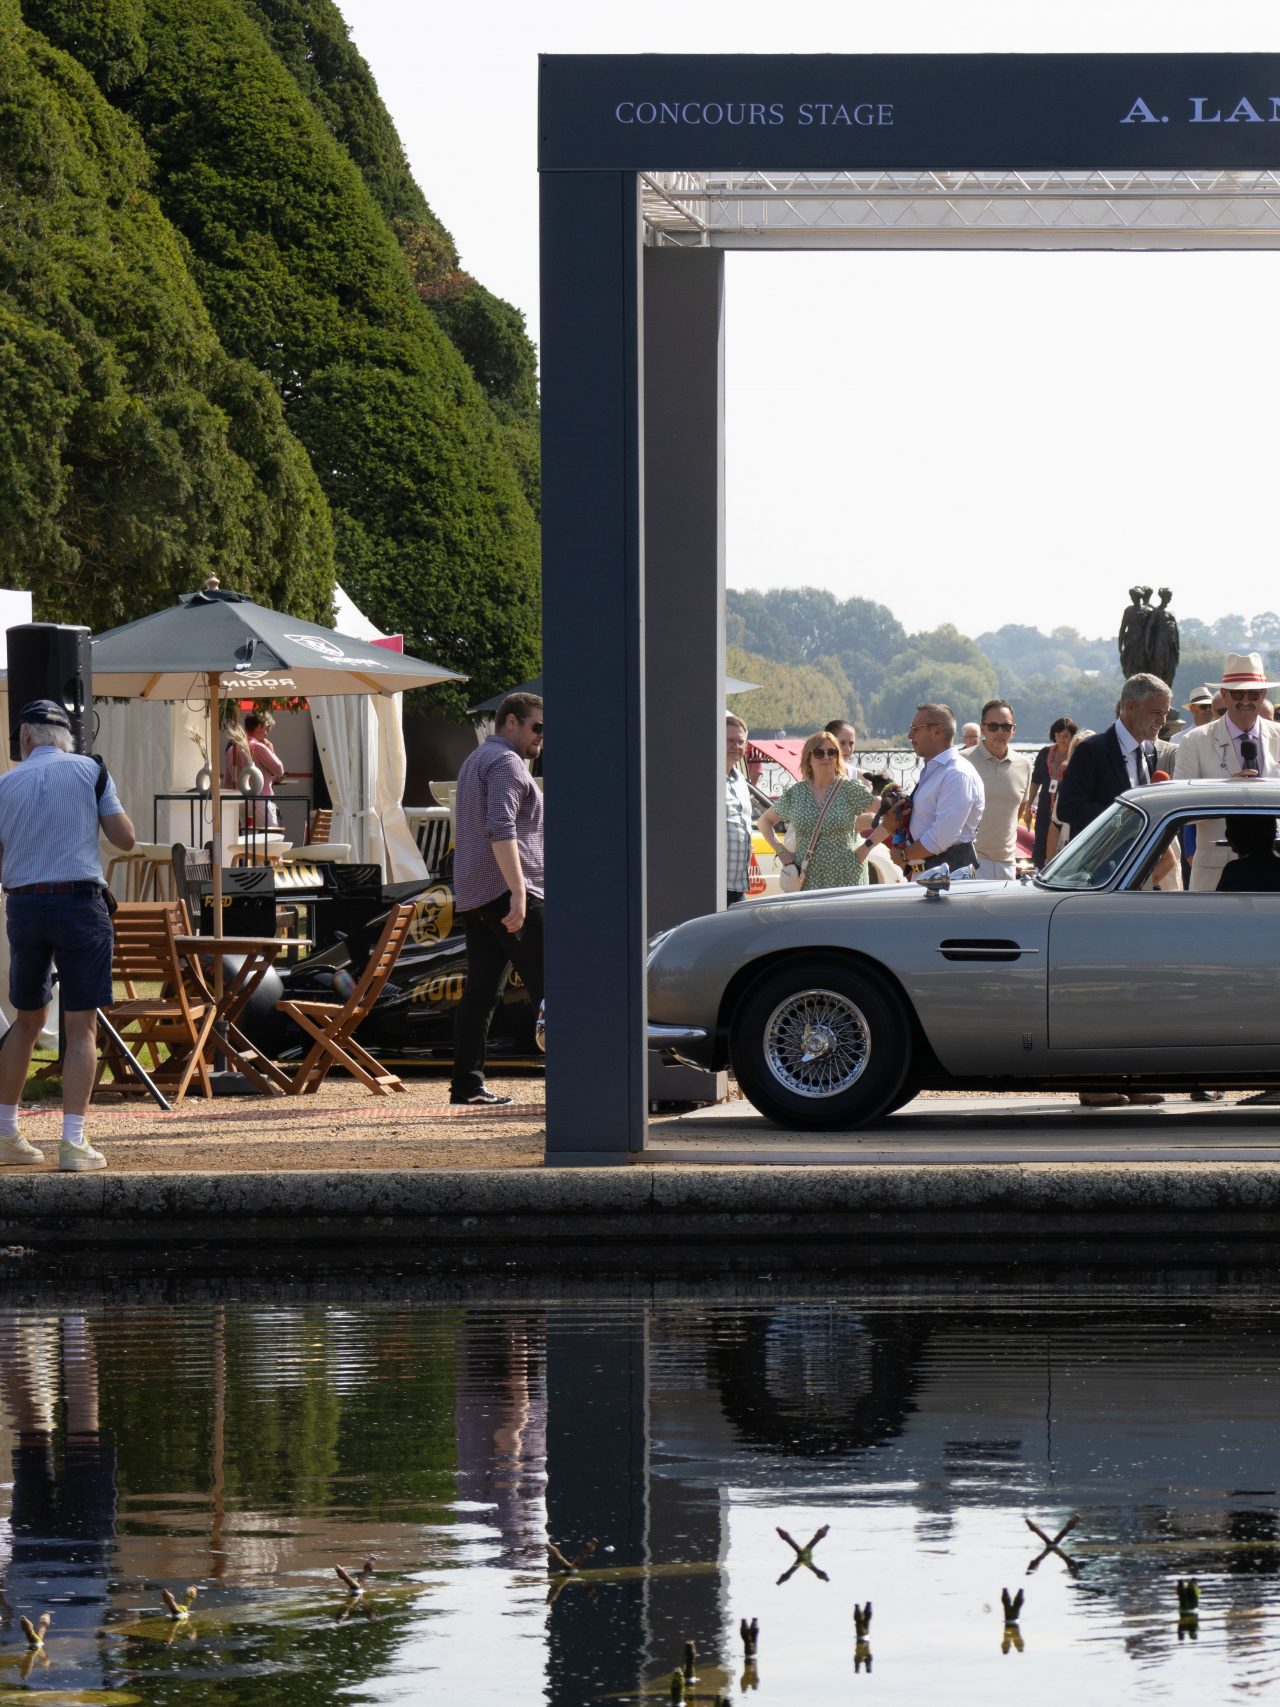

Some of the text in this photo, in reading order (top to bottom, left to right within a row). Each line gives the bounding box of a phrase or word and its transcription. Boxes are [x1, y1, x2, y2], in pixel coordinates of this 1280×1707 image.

[614, 102, 895, 126] CONCOURS STAGE
[1119, 96, 1169, 123] A.
[274, 865, 323, 888] DIN
[412, 973, 465, 1003] ROD
